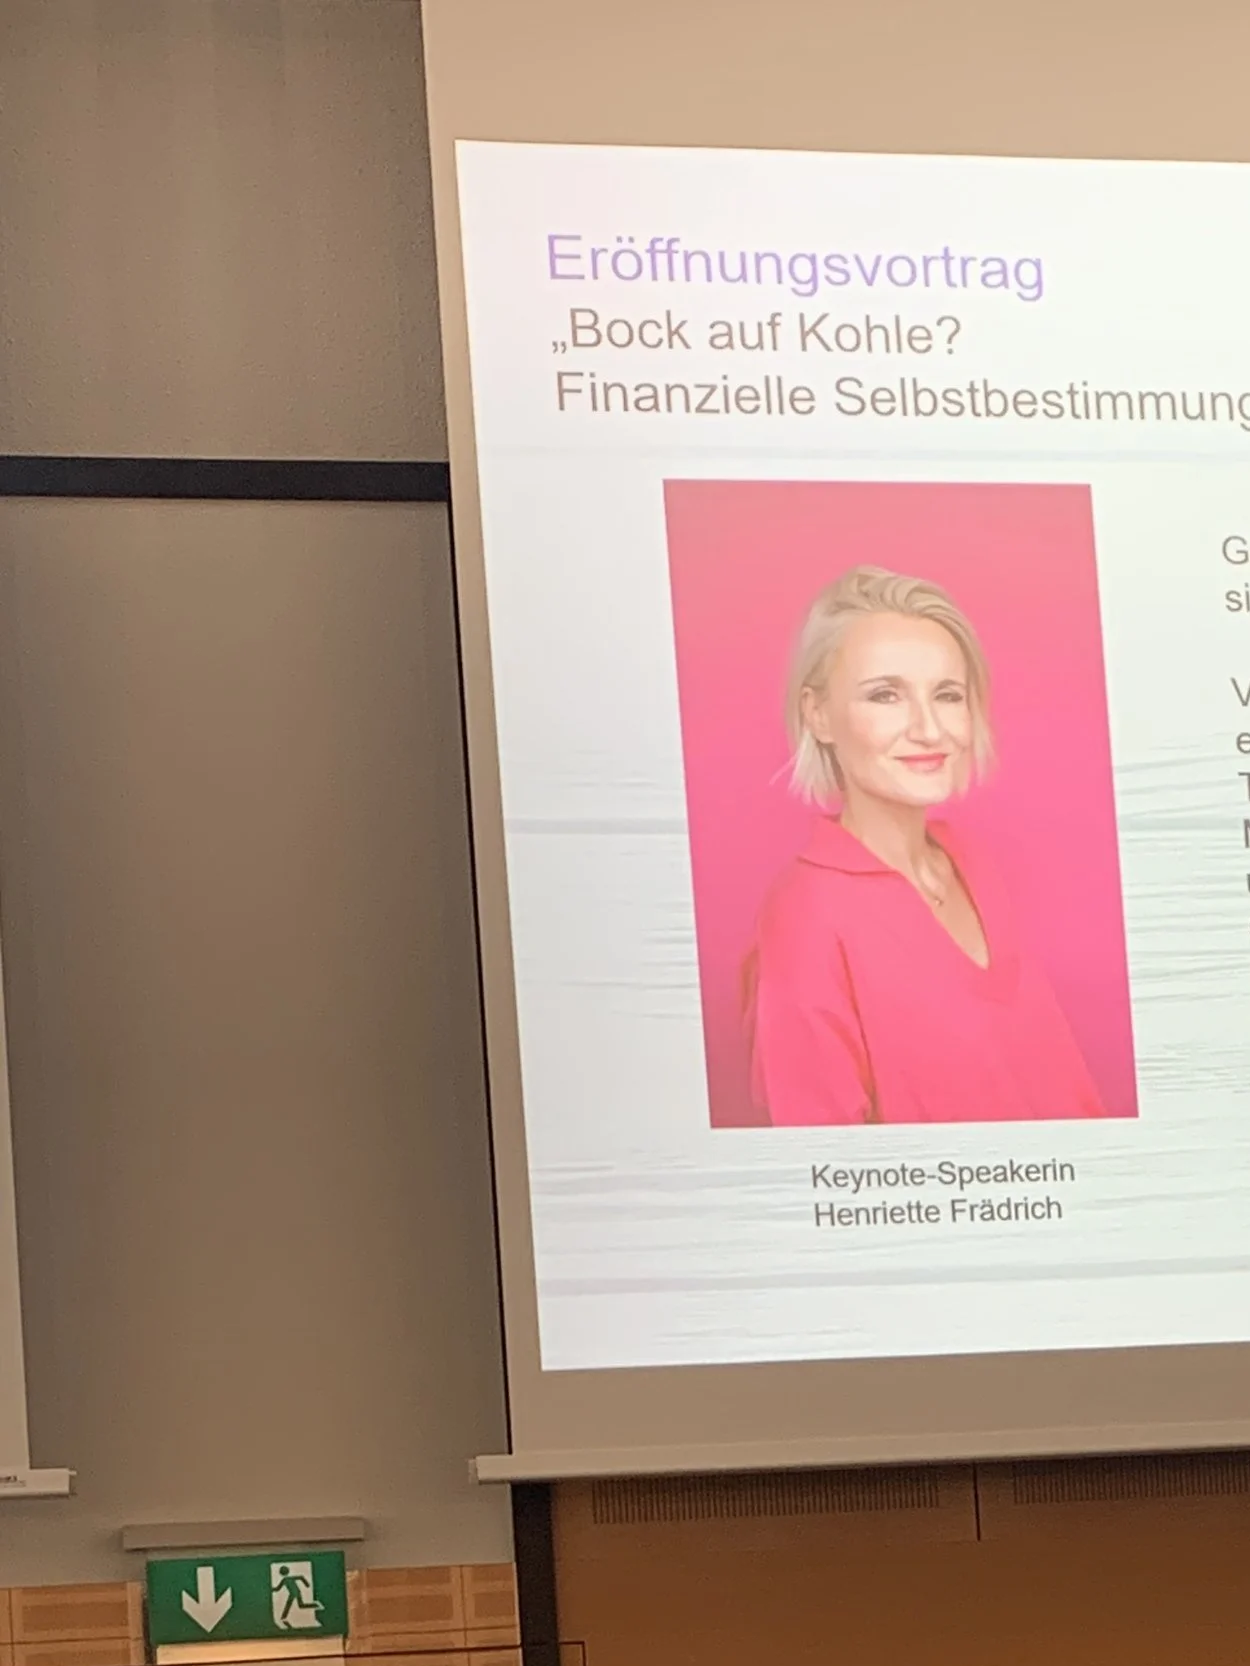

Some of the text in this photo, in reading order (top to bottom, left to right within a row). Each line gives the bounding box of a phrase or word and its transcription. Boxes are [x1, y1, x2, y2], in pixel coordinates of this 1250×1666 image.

[548, 235, 1043, 301] Eröffnungsvortrag
[552, 308, 960, 354] „Bock auf Kohle?
[557, 371, 815, 415] Finanzielle
[812, 1159, 1075, 1194] Keynote-Speakerin
[815, 1196, 1062, 1226] Henriette Frädrich
